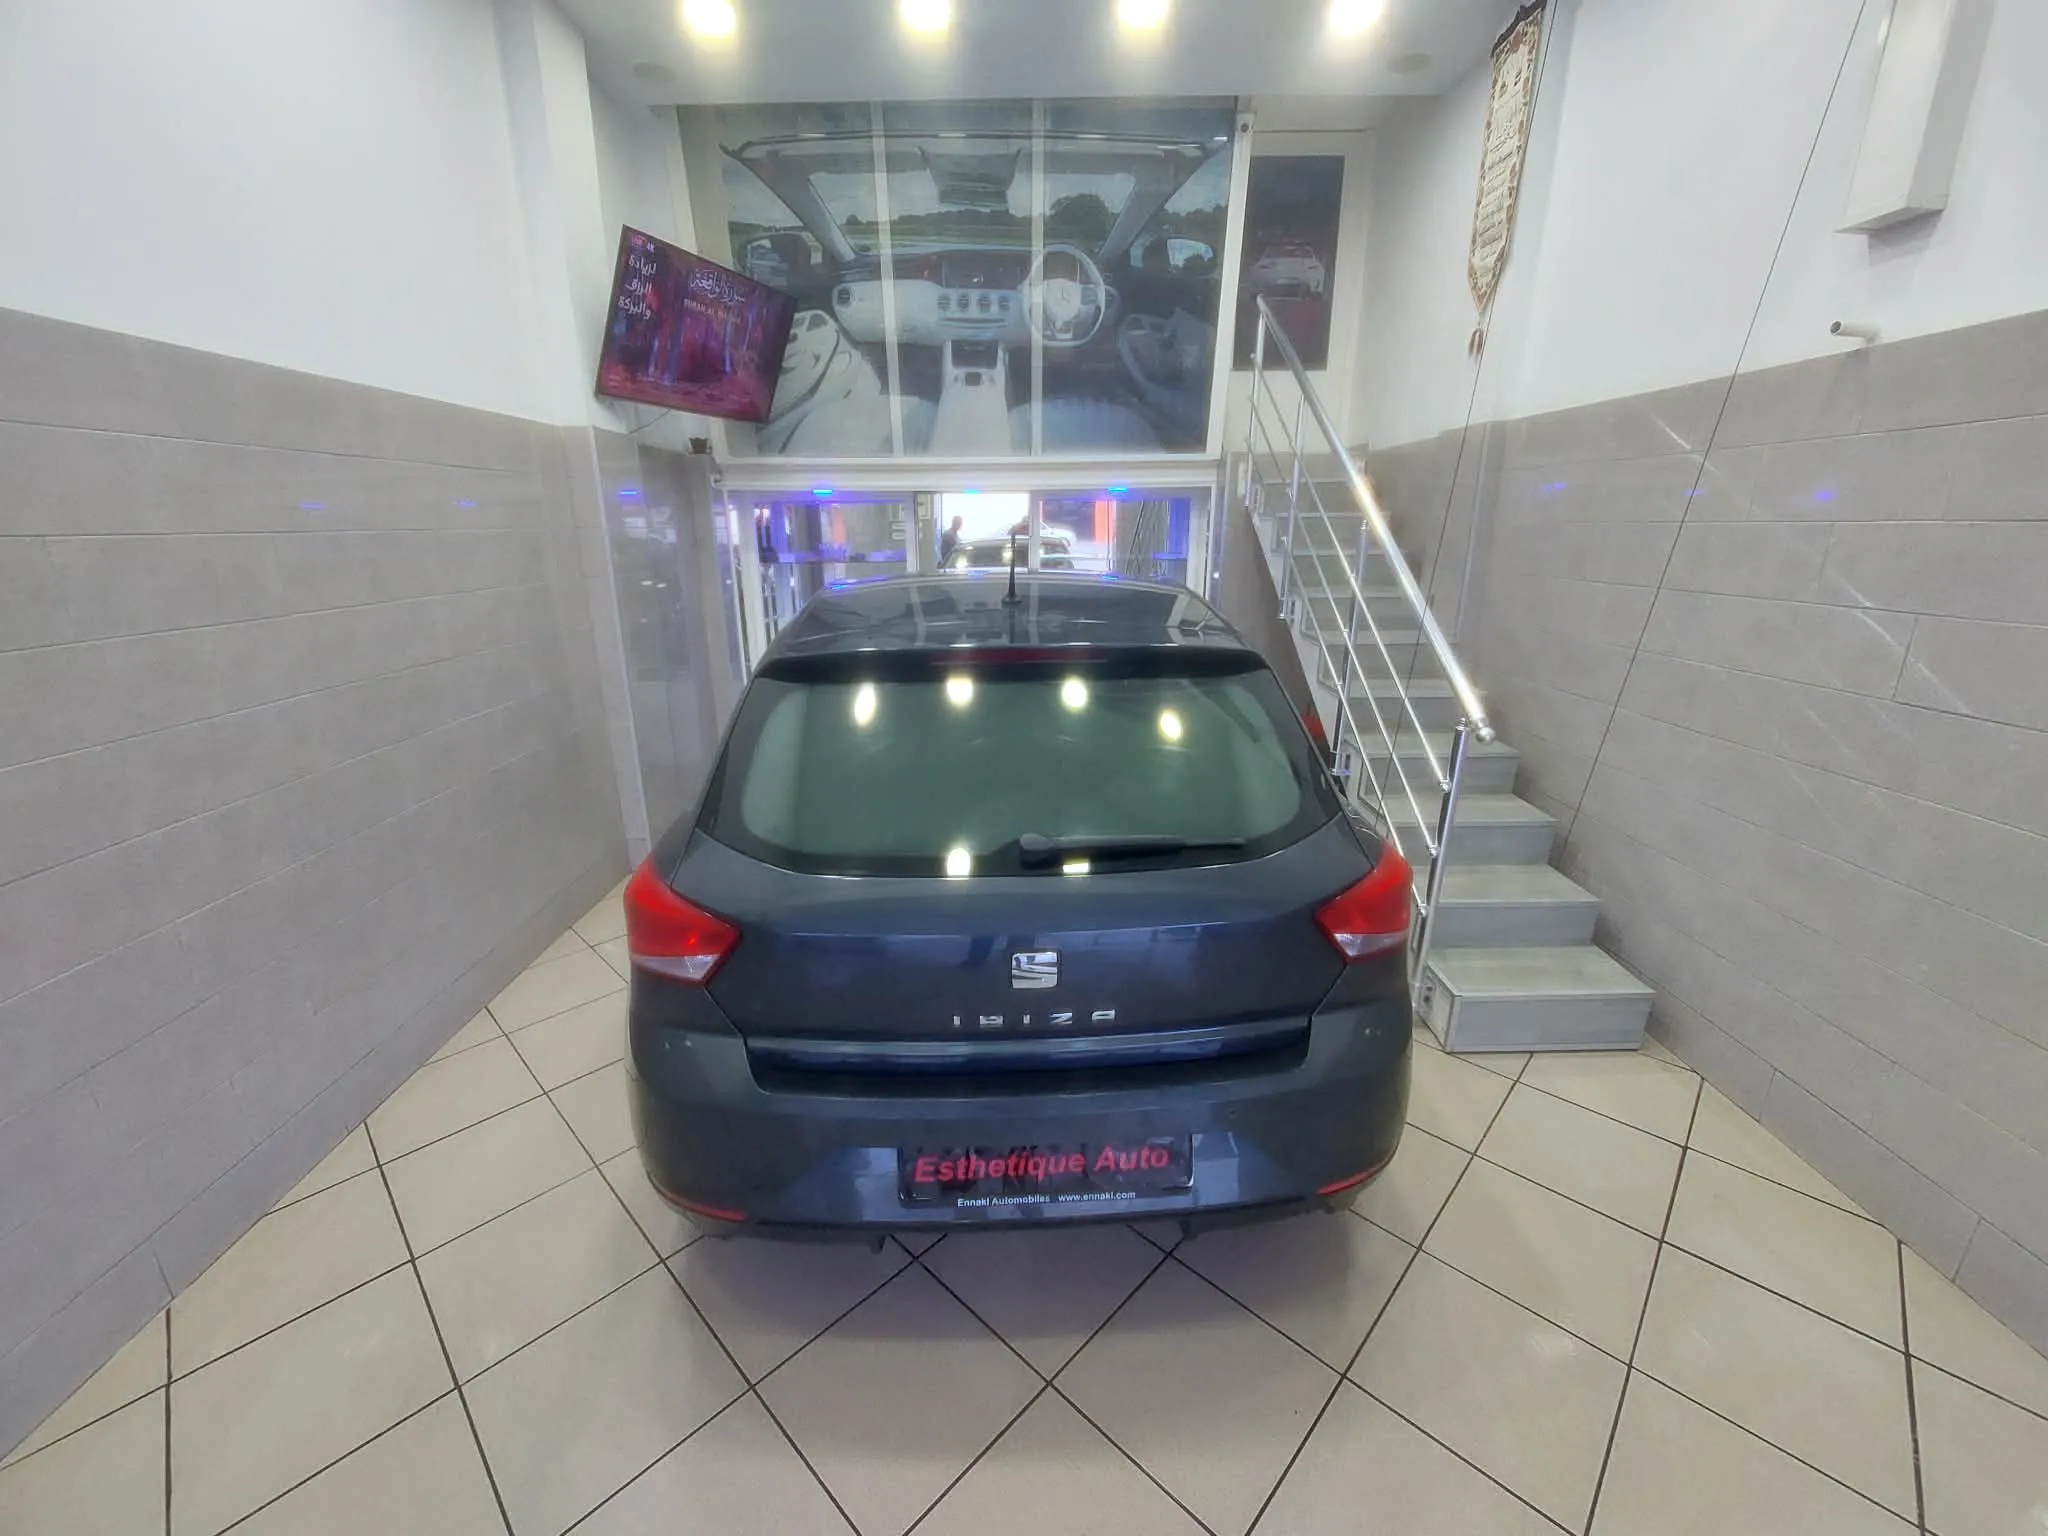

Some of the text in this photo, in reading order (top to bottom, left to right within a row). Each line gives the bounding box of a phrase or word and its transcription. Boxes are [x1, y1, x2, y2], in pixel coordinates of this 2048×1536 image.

[953, 1009, 1116, 1028] IBIZA
[914, 1145, 1170, 1184] Esthetique Auto
[992, 1195, 1050, 1207] Automobiles
